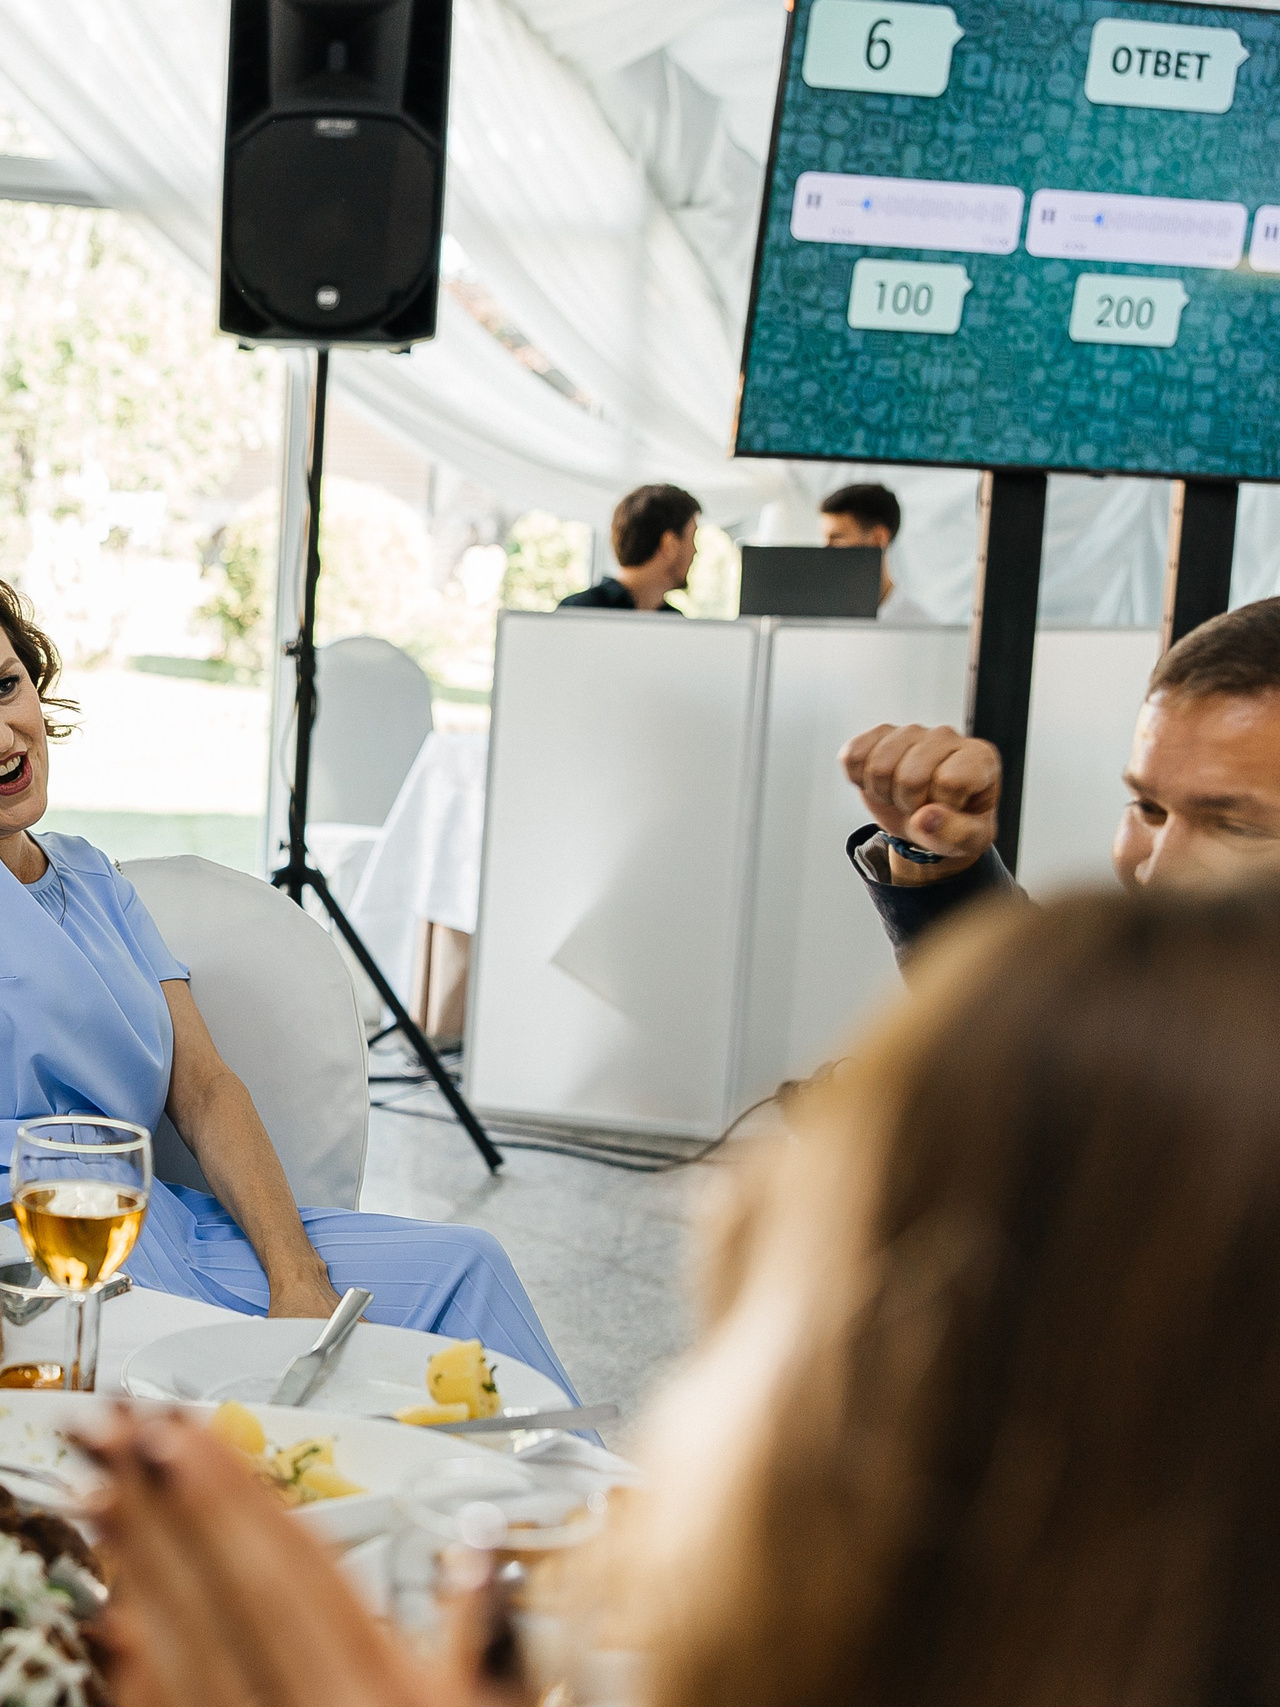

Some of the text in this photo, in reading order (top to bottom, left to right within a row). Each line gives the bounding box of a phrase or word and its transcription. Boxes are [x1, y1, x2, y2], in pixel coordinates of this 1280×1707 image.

[866, 19, 891, 70] 6
[1112, 46, 1211, 80] ОТВЕТ
[875, 280, 933, 316] 100
[1096, 295, 1154, 331] 200
